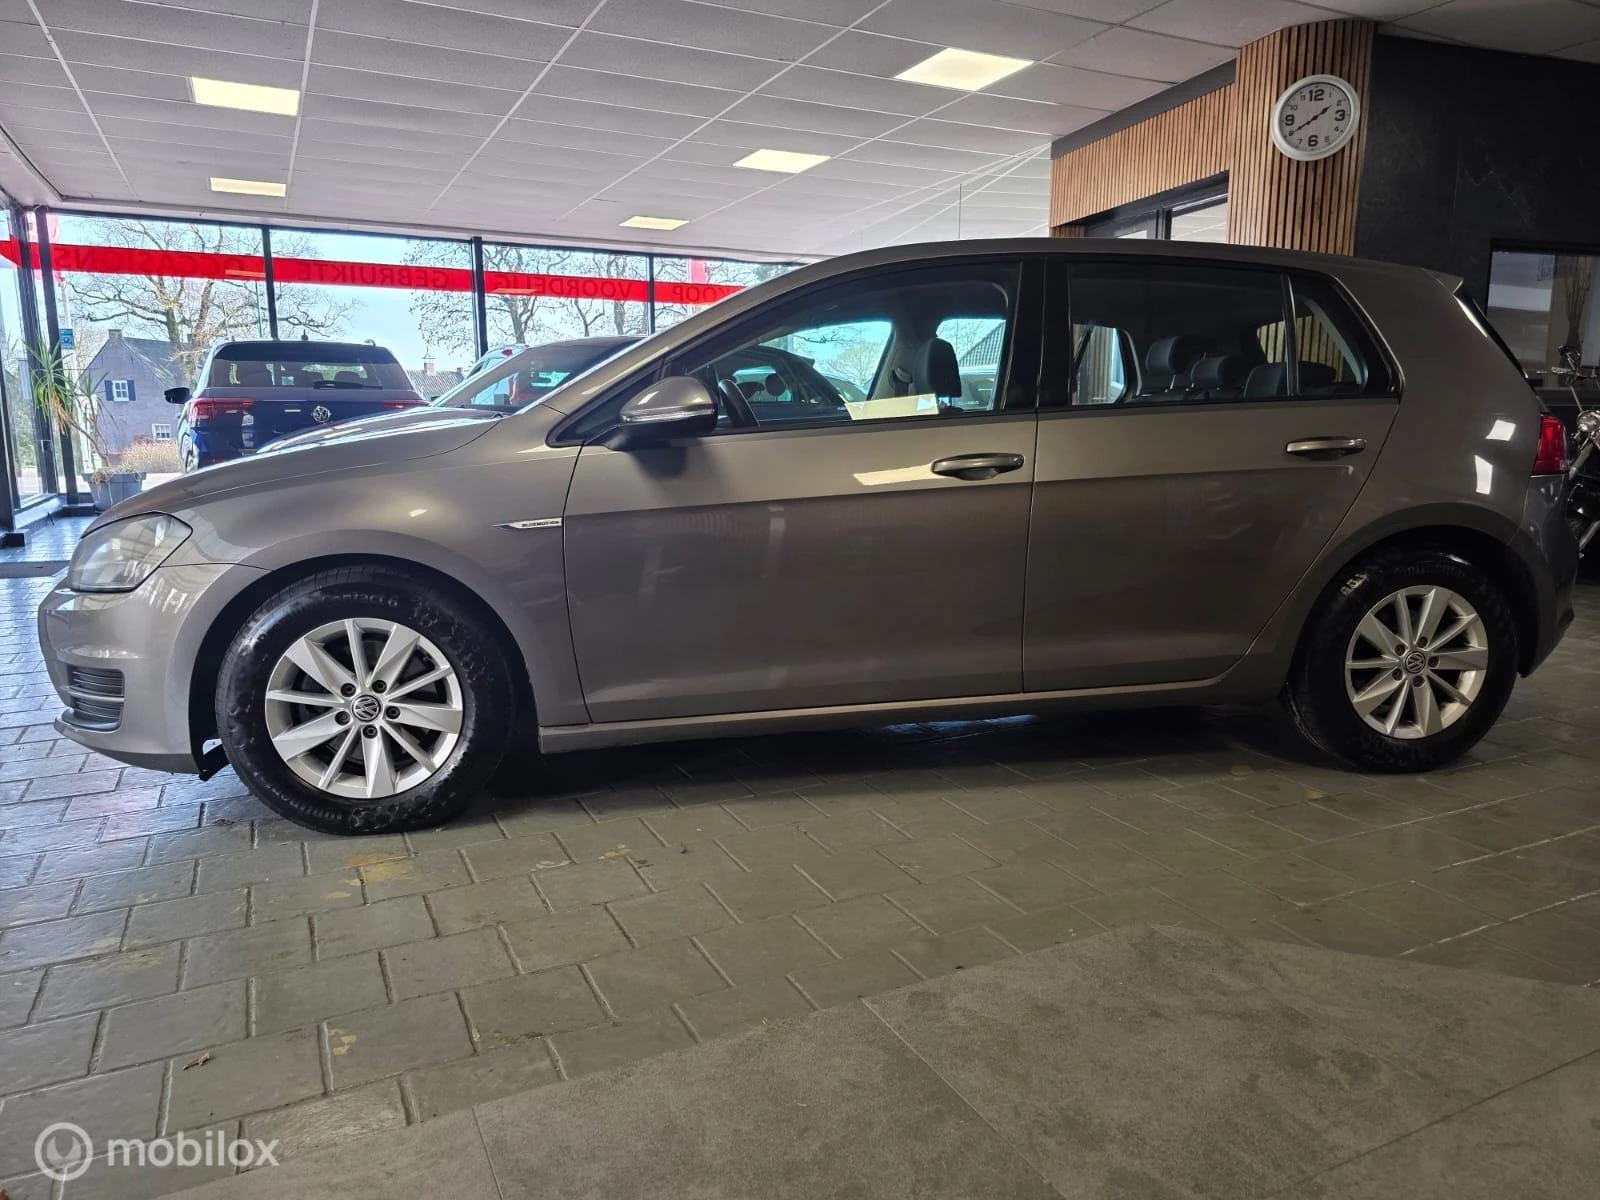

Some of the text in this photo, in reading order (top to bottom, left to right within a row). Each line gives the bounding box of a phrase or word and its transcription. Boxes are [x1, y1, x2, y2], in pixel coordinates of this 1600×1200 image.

[1308, 89, 1325, 102] 12
[1285, 109, 1346, 126] 9 3
[1308, 134, 1318, 147] 6
